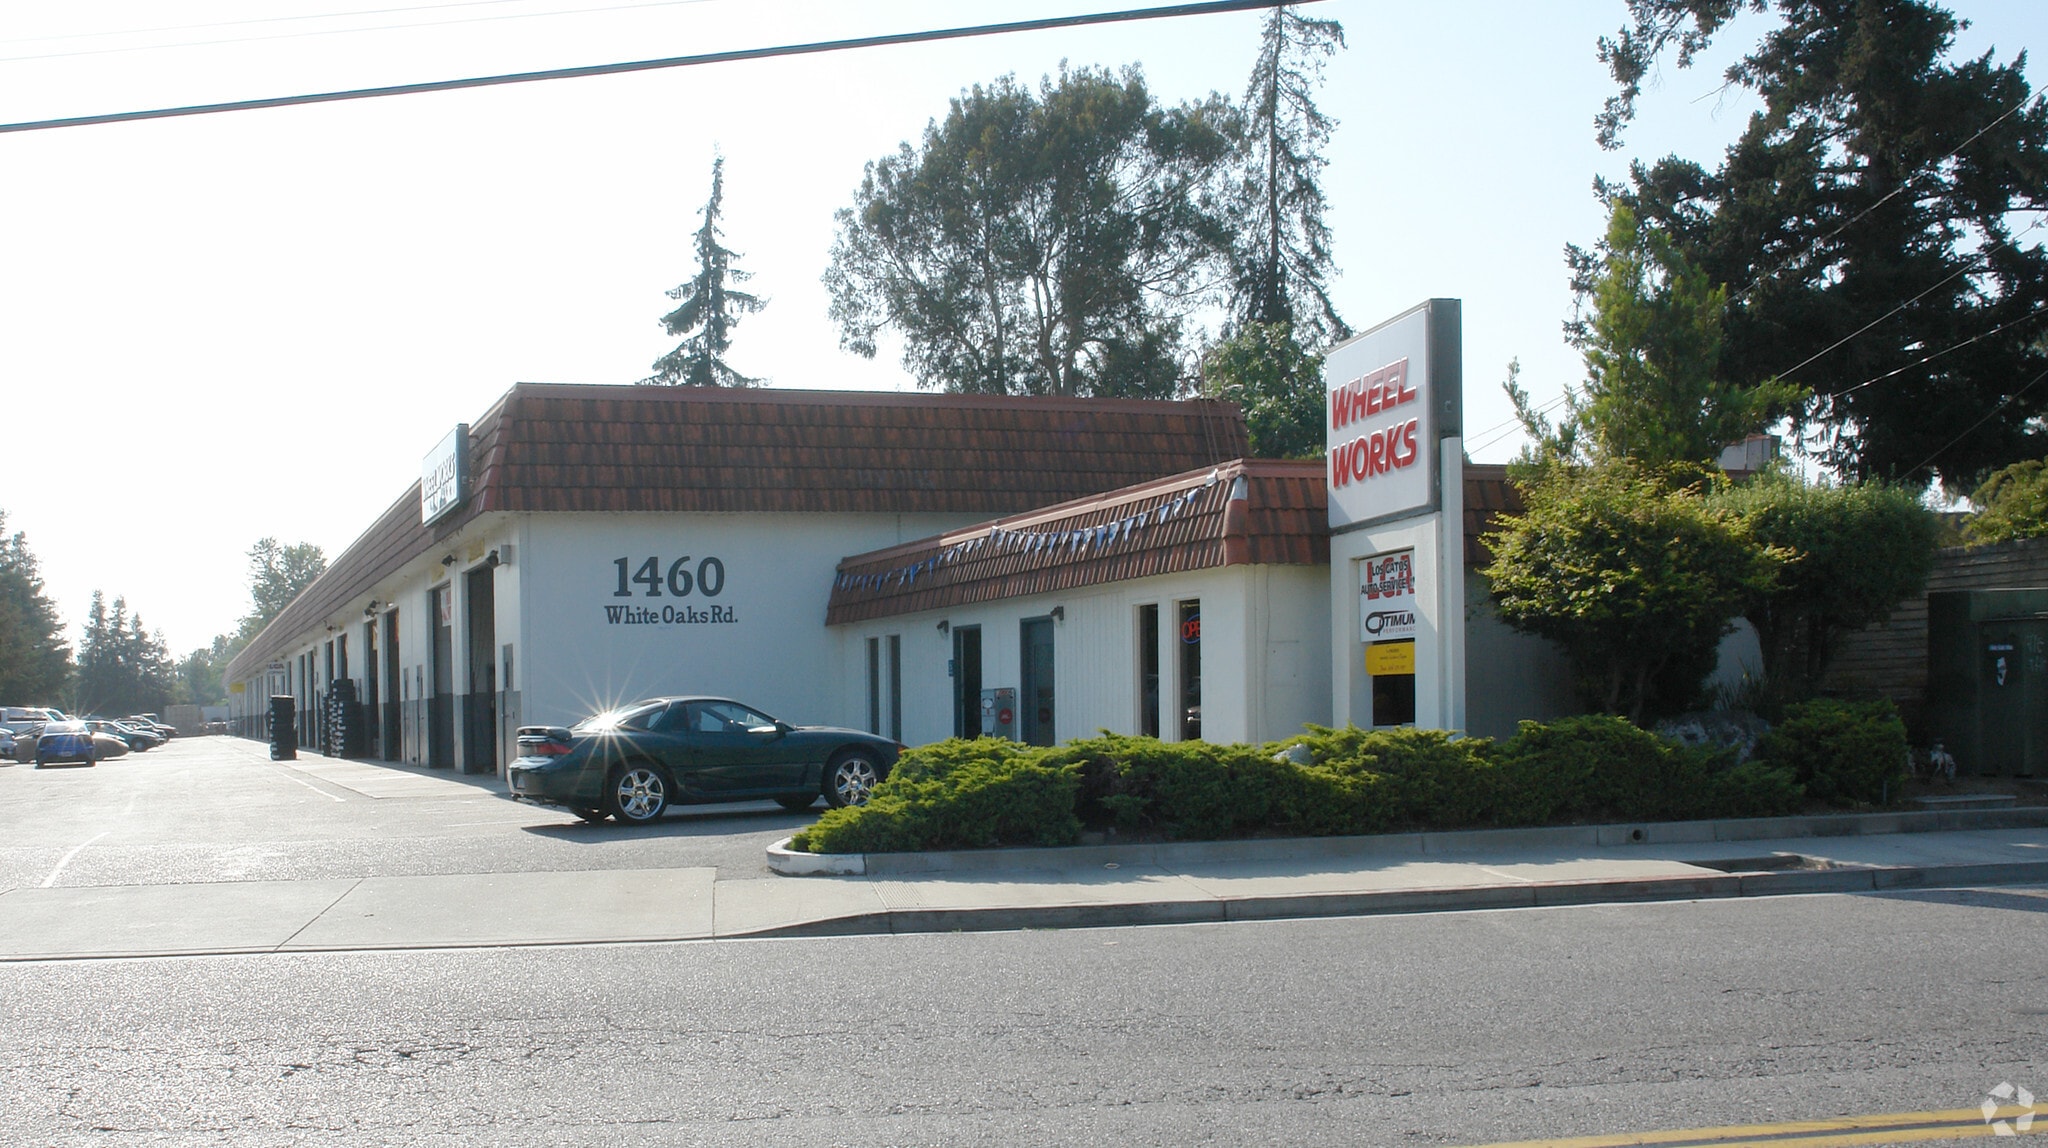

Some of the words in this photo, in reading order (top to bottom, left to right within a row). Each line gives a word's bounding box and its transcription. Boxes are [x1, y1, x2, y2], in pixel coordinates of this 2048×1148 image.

[1332, 356, 1417, 431] WHEEL
[1332, 417, 1418, 488] WORKS
[613, 556, 725, 597] 1460
[1372, 564, 1383, 577] LOS
[1385, 560, 1408, 575] GATOS
[1361, 582, 1378, 595] AUTO
[604, 605, 659, 624] White
[662, 605, 709, 624] Oaks
[711, 605, 738, 624] Rd.
